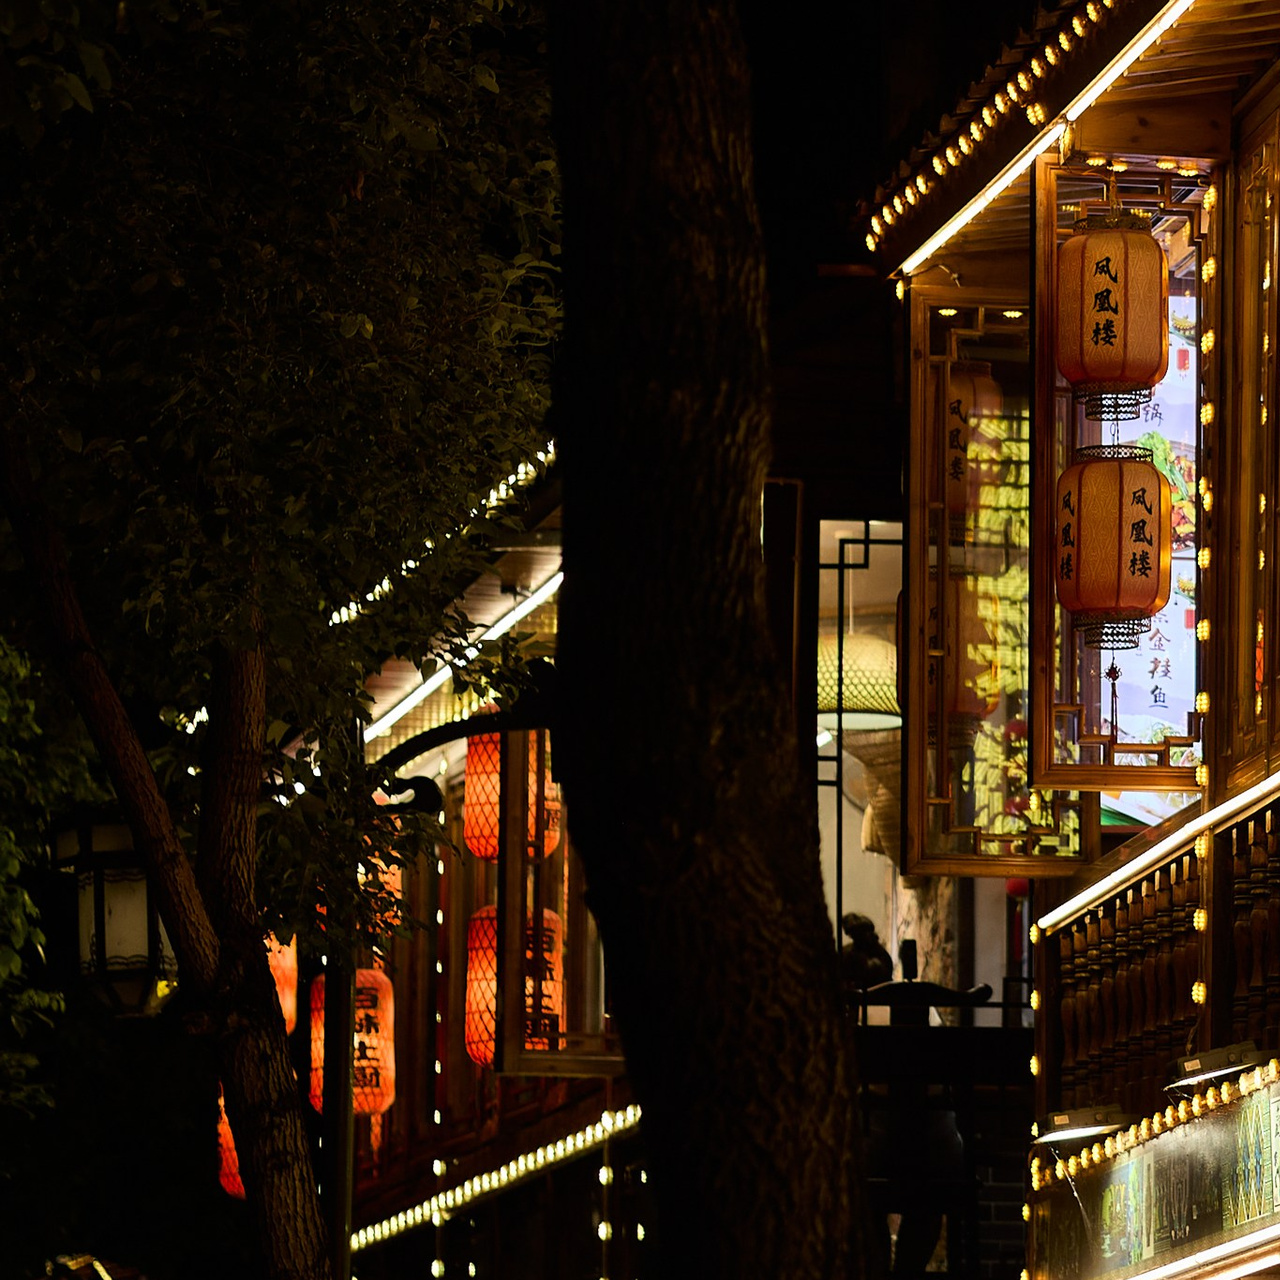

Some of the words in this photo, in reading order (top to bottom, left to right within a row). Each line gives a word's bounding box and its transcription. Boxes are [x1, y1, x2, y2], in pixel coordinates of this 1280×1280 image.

[1090, 256, 1119, 347] 凤凰楼
[1060, 489, 1075, 581] 凤凰楼
[1129, 487, 1154, 579] 凤凰楼
